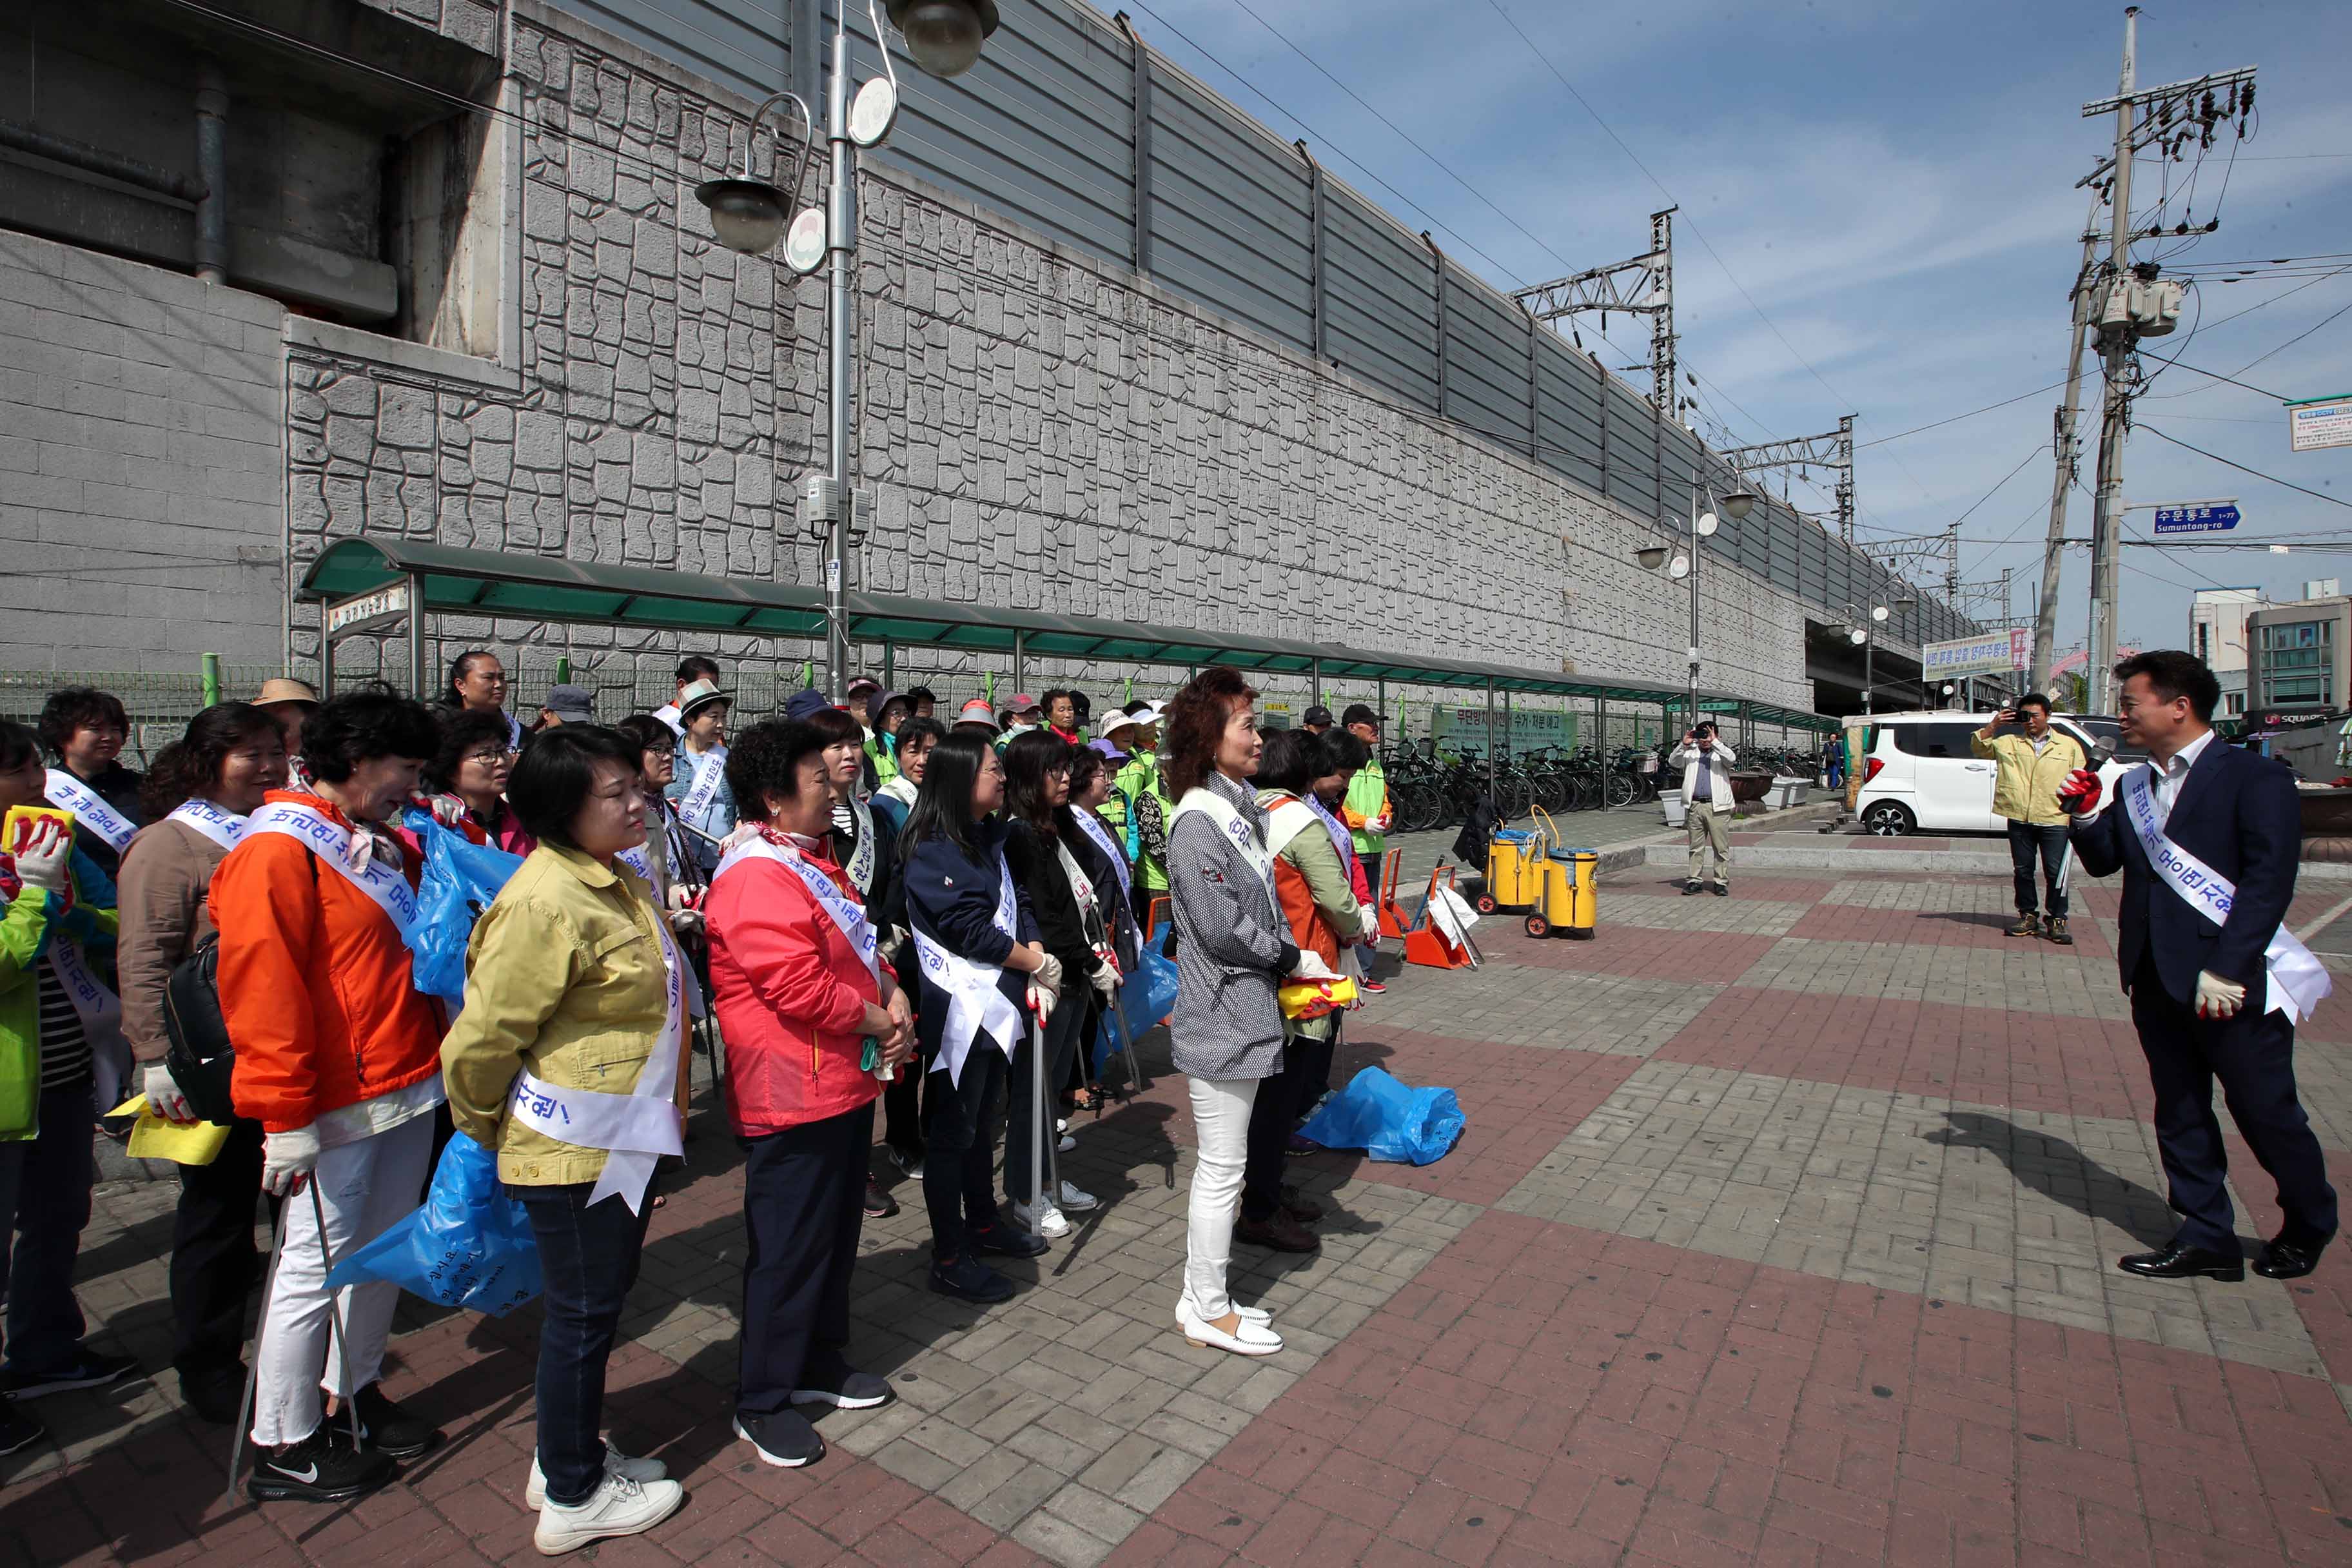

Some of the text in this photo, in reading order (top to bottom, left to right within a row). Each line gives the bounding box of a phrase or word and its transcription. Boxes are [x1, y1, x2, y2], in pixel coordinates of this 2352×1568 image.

[2158, 508, 2211, 522] 수문통로
[1546, 715, 1560, 730] 예고
[706, 759, 723, 785] 버리면
[269, 809, 338, 844] 버리면
[2133, 780, 2151, 818] 버리면
[2158, 848, 2207, 889] 모으면
[922, 945, 950, 977] 자원!
[516, 1082, 571, 1125] 자원!
